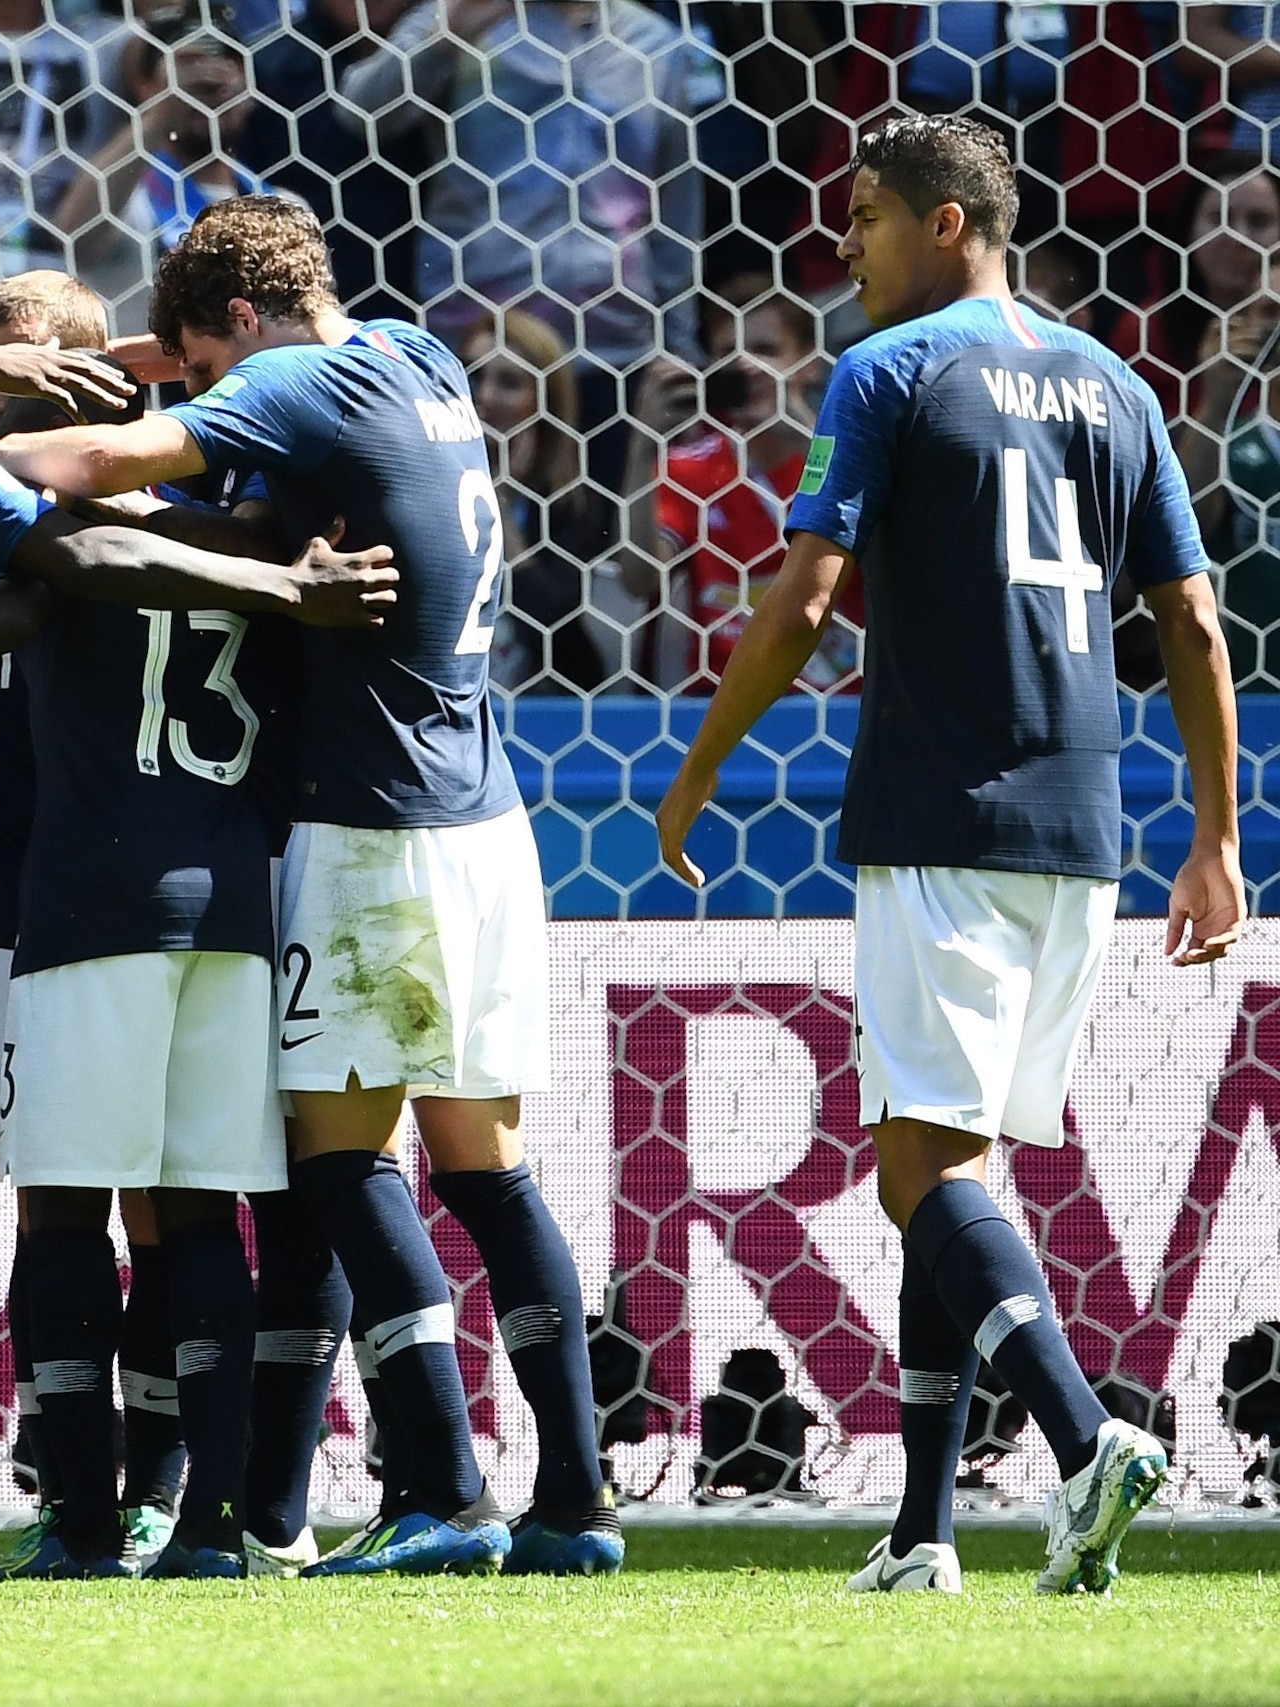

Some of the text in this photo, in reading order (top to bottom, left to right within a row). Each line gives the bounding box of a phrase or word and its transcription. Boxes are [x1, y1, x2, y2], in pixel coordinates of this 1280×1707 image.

[980, 366, 1108, 427] VARANE
[454, 469, 504, 655] 2
[1004, 448, 1104, 654] 4
[136, 608, 260, 786] 13
[282, 942, 320, 1021] 2
